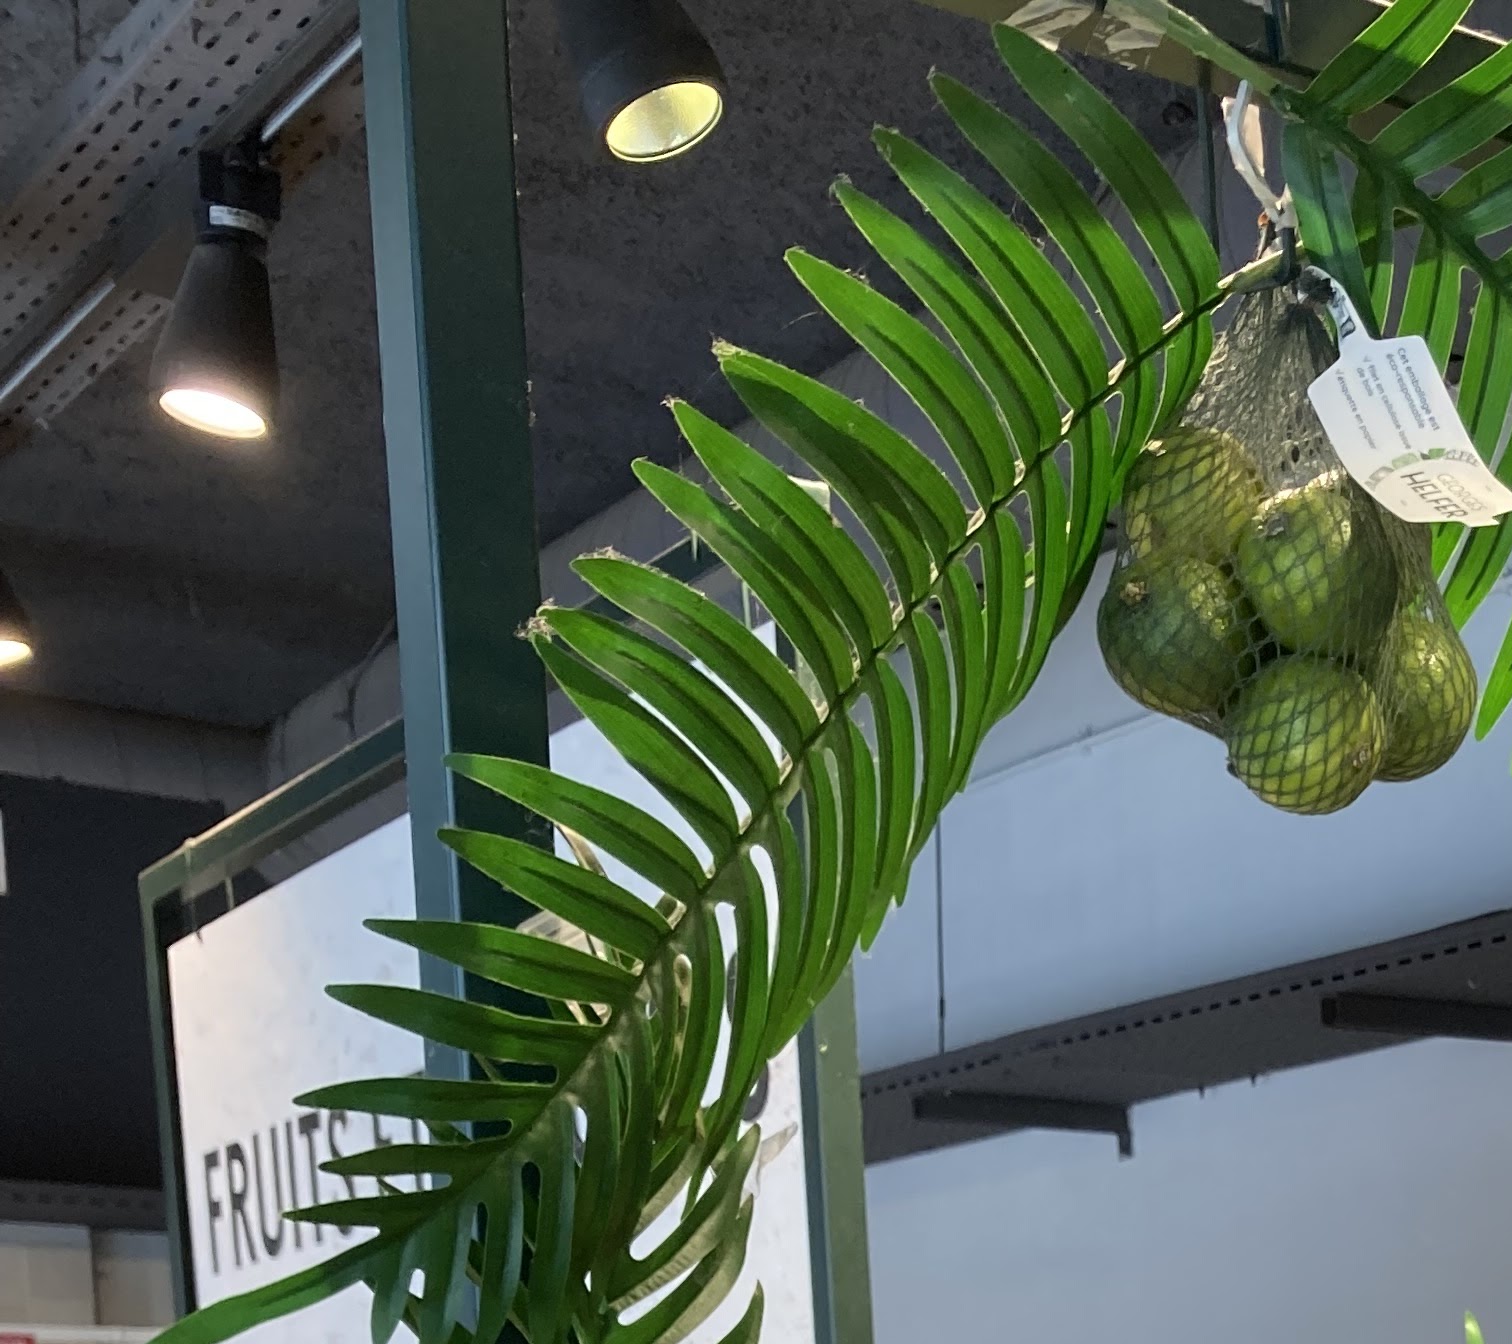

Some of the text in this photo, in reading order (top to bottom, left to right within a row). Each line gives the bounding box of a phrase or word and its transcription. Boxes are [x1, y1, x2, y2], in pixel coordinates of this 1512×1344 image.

[1397, 347, 1409, 364] Cet
[1404, 361, 1433, 417] emballage
[1399, 471, 1470, 520] HELFER
